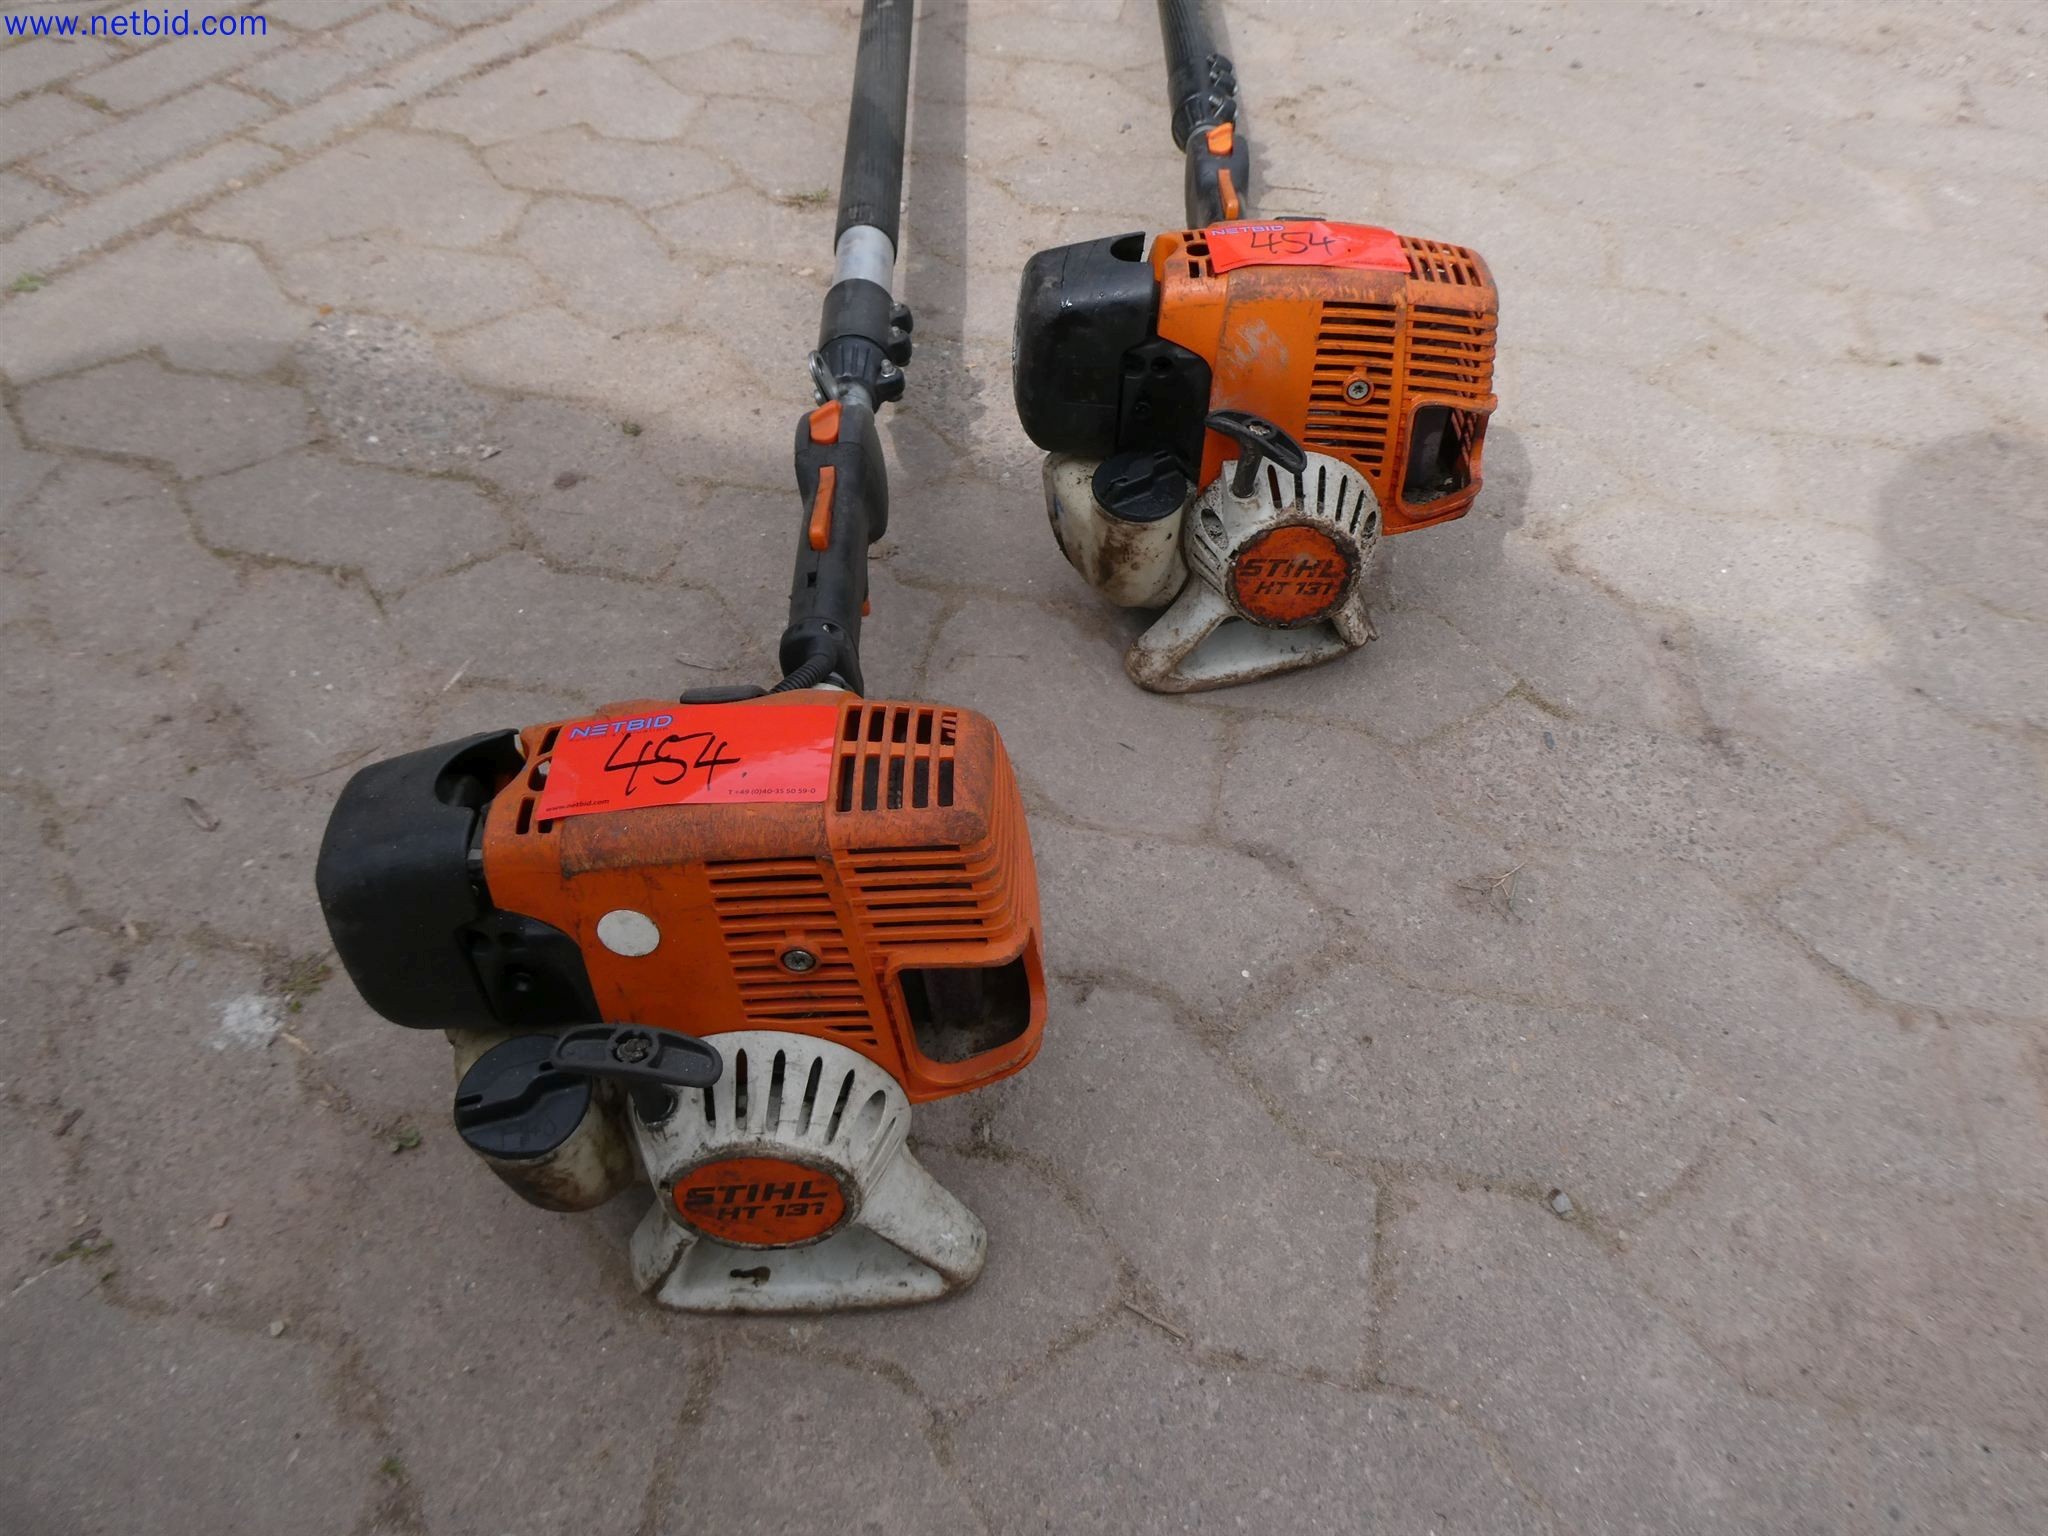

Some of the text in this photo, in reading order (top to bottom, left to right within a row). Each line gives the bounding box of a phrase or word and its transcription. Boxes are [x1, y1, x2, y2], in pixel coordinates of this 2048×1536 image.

[1211, 224, 1285, 236] NETBID
[1251, 231, 1337, 256] 454
[1238, 558, 1343, 578] STIHL
[1254, 581, 1335, 596] HT 131
[569, 714, 674, 740] NETBID
[604, 731, 741, 796] 454
[545, 800, 610, 812] www.netbid.com
[684, 1181, 828, 1211] STIHL
[717, 1202, 826, 1220] HT 131
